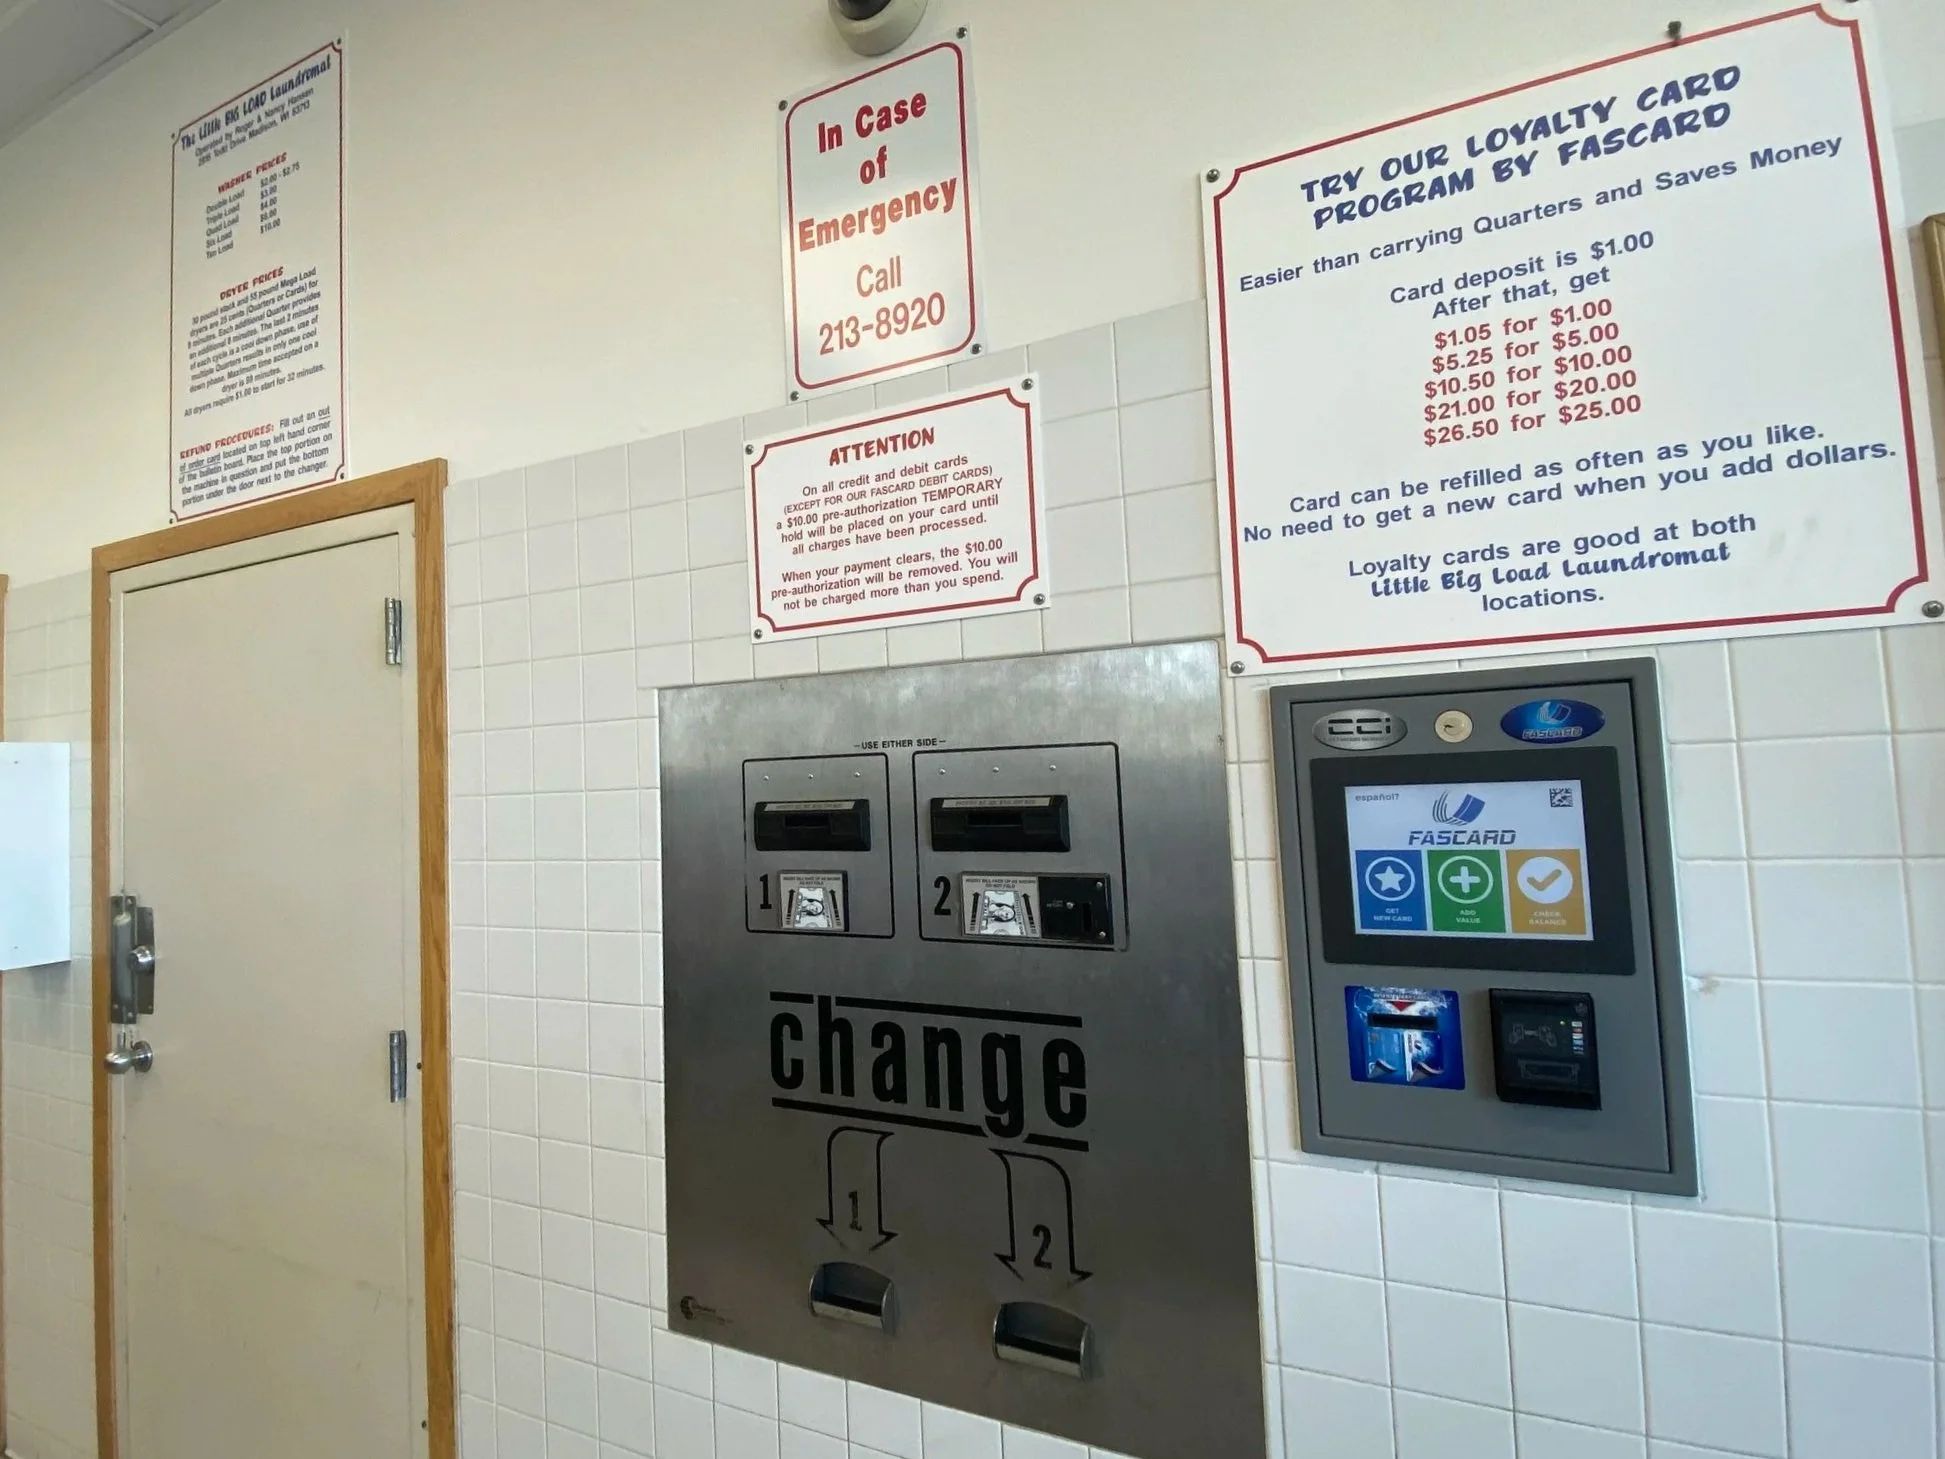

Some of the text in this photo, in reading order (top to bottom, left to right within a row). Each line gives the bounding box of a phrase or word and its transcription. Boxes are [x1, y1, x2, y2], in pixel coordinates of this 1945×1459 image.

[225, 105, 240, 127] BIG
[243, 90, 267, 116] LOAD
[270, 53, 331, 101] Laundromat
[818, 92, 928, 153] In Case
[1300, 65, 1741, 202] TRY OUR LOYALTY CARD
[218, 152, 287, 194] WASHER PRICES
[860, 145, 887, 185] of
[1312, 101, 1731, 230] PROGRAM BY FASCARD
[798, 177, 957, 252] Emergency
[1239, 136, 1842, 292] Easier than carrying Quarters and Saves Money
[219, 266, 284, 301] DRYER PRICES
[856, 255, 902, 298] Call
[1390, 230, 1654, 304] Card deposit is $1.00
[1431, 265, 1610, 319] After that, get
[819, 292, 946, 355] 213-8920
[1431, 321, 1619, 375] $5.25 for $5.00
[1434, 298, 1612, 351] $1.05 for $1.00
[1423, 369, 1637, 424] $21.00 for $20.00
[1424, 344, 1632, 400] $10.50 for $10.00
[180, 405, 330, 460] REFUND PROCEDURES: Fill out an out
[828, 426, 934, 466] ATTENTION
[1423, 394, 1641, 447] $26.50 for $25.00
[227, 483, 237, 494] the
[239, 477, 254, 491] door
[256, 475, 272, 486] next
[274, 472, 282, 481] to
[284, 468, 295, 479] the
[783, 464, 992, 515] (EXCEPT FOR OUR FASCARD DEBIT CARDS)
[801, 454, 968, 497] On all credit and debit cards
[776, 476, 1003, 530] a $10.00 pre-authorization TEMPORARY
[780, 493, 998, 543] hold will be placed on your card until
[781, 537, 1003, 583] When your payment clears, the $10.00
[1348, 513, 1756, 578] Loyalty cards are good at both
[1371, 541, 1731, 597] Little Big Load Laundromat
[783, 569, 1004, 611] not be charged more than you spend.
[1482, 587, 1604, 612] locations.
[861, 738, 938, 750] USE EITHER SIDE
[1408, 830, 1517, 846] FASCARD
[759, 874, 773, 909] 1
[934, 875, 952, 916] 2
[770, 995, 1088, 1139] change
[847, 1190, 863, 1232] 1
[1032, 1224, 1052, 1270] 2
